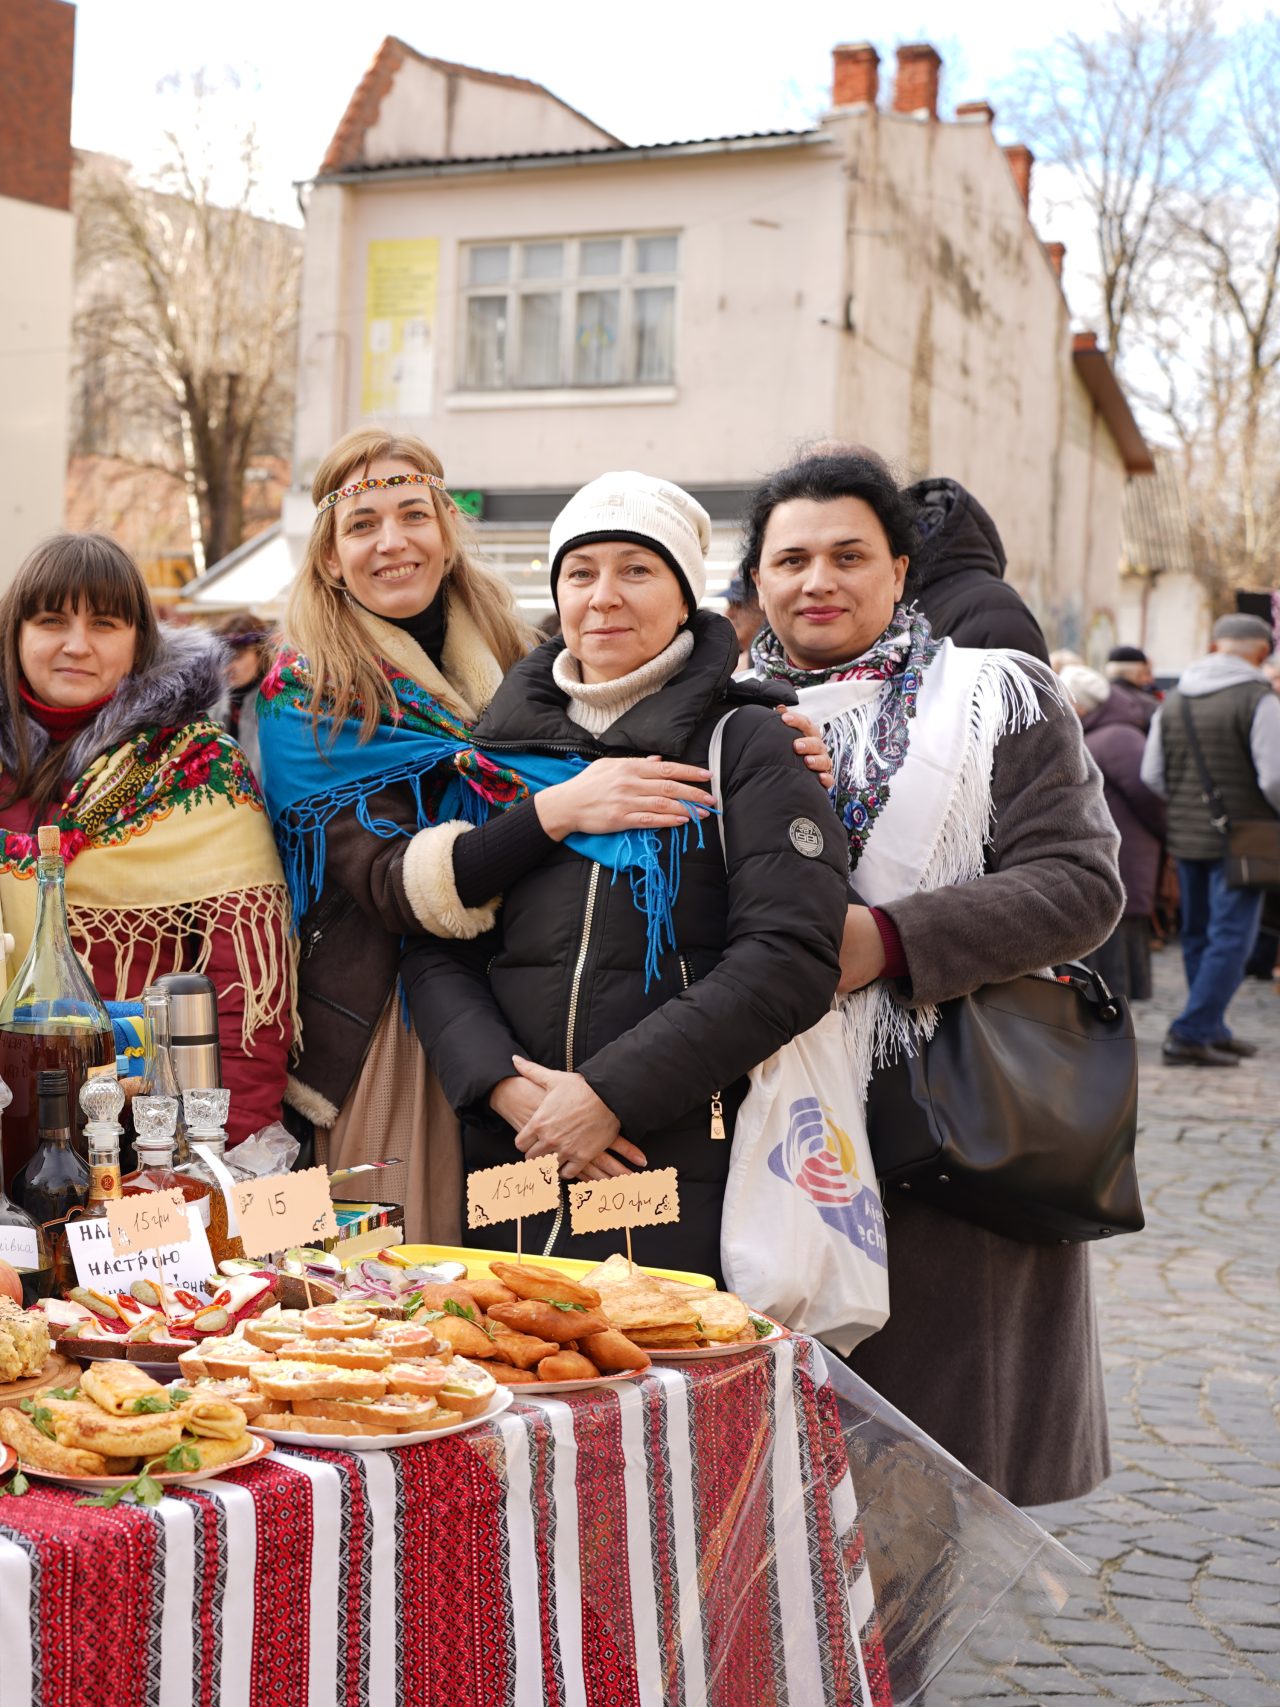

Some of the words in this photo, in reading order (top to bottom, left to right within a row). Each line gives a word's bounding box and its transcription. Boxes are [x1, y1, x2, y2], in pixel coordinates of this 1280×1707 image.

[492, 1177, 514, 1200] 15
[267, 1191, 287, 1217] 15
[598, 1192, 625, 1213] 20
